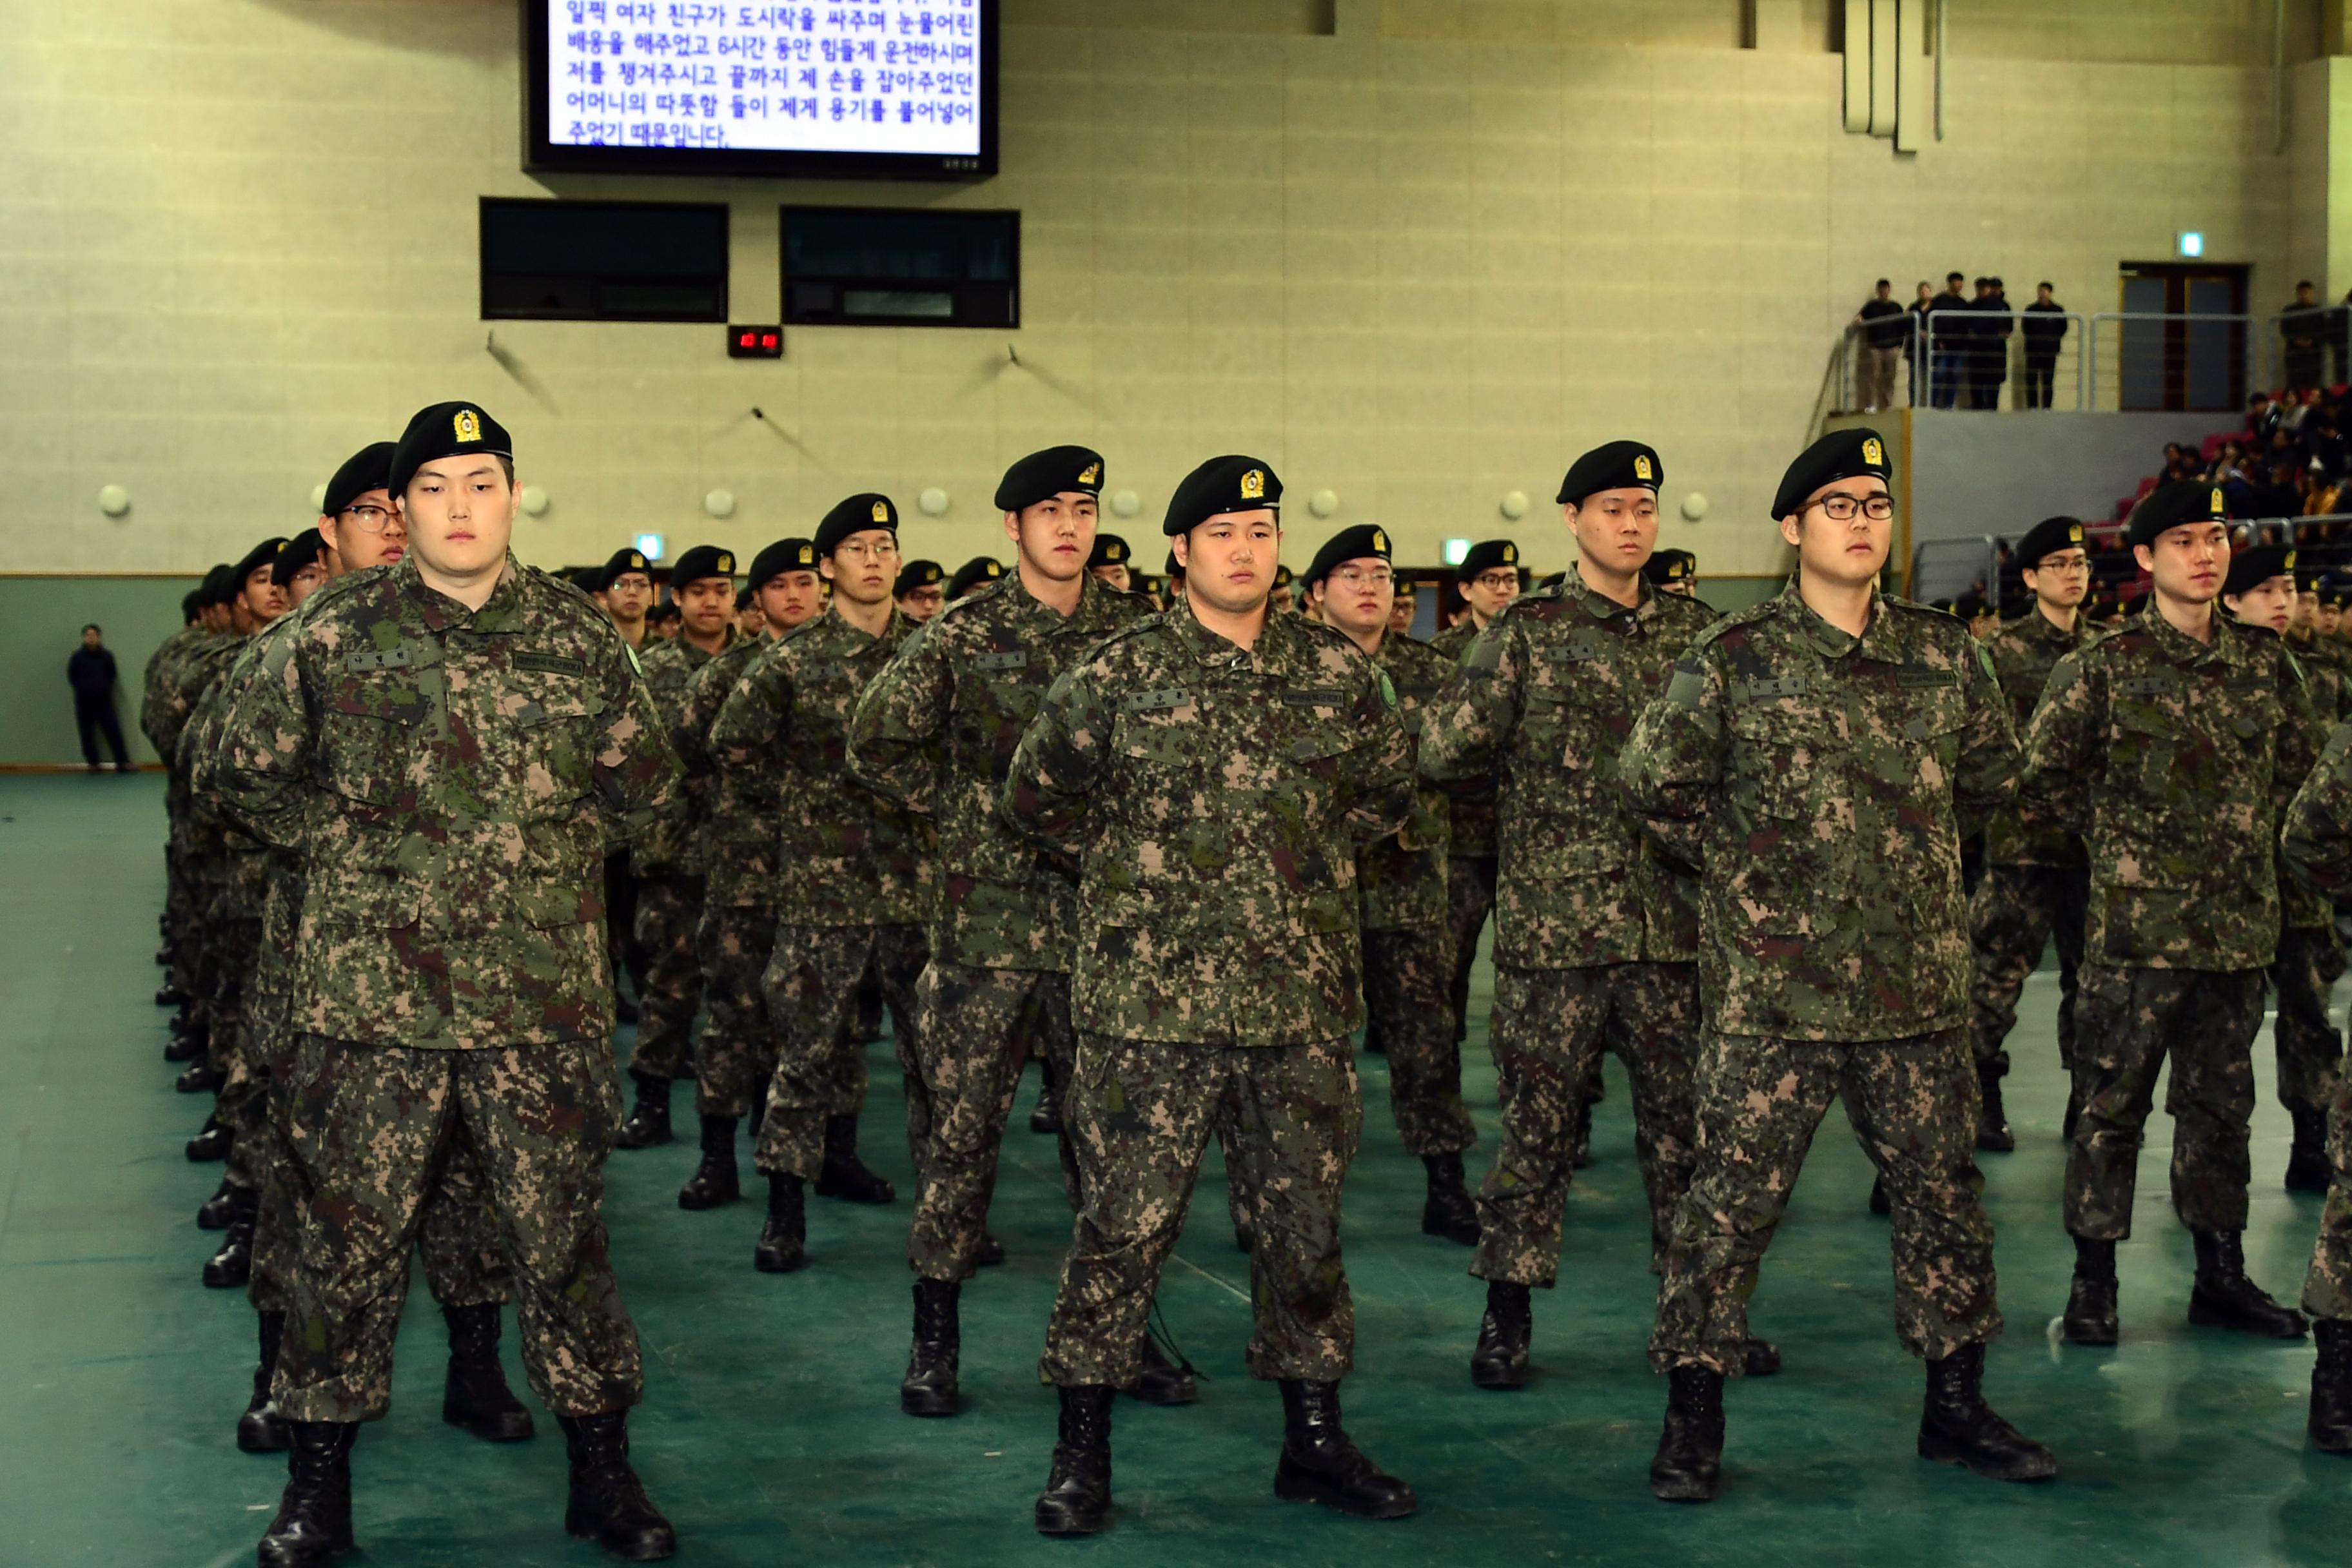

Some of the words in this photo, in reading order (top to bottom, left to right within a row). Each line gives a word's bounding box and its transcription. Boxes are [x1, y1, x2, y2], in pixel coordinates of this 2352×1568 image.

[617, 3, 655, 24] 여자
[669, 4, 725, 27] 친구가
[739, 7, 815, 32] 도시락을
[827, 10, 885, 32] 싸주며
[898, 12, 973, 36] 눈물어린
[634, 33, 709, 56] 해주었고
[718, 36, 765, 59] 6시간
[776, 37, 811, 61] 동안
[821, 39, 875, 63] 힘들게
[884, 41, 972, 64] 운전하시며
[569, 61, 605, 84] 저를
[829, 69, 865, 92] 손을
[877, 70, 972, 95] 잡아주었던
[567, 92, 645, 113] 어머니의
[830, 100, 885, 122] 용기를
